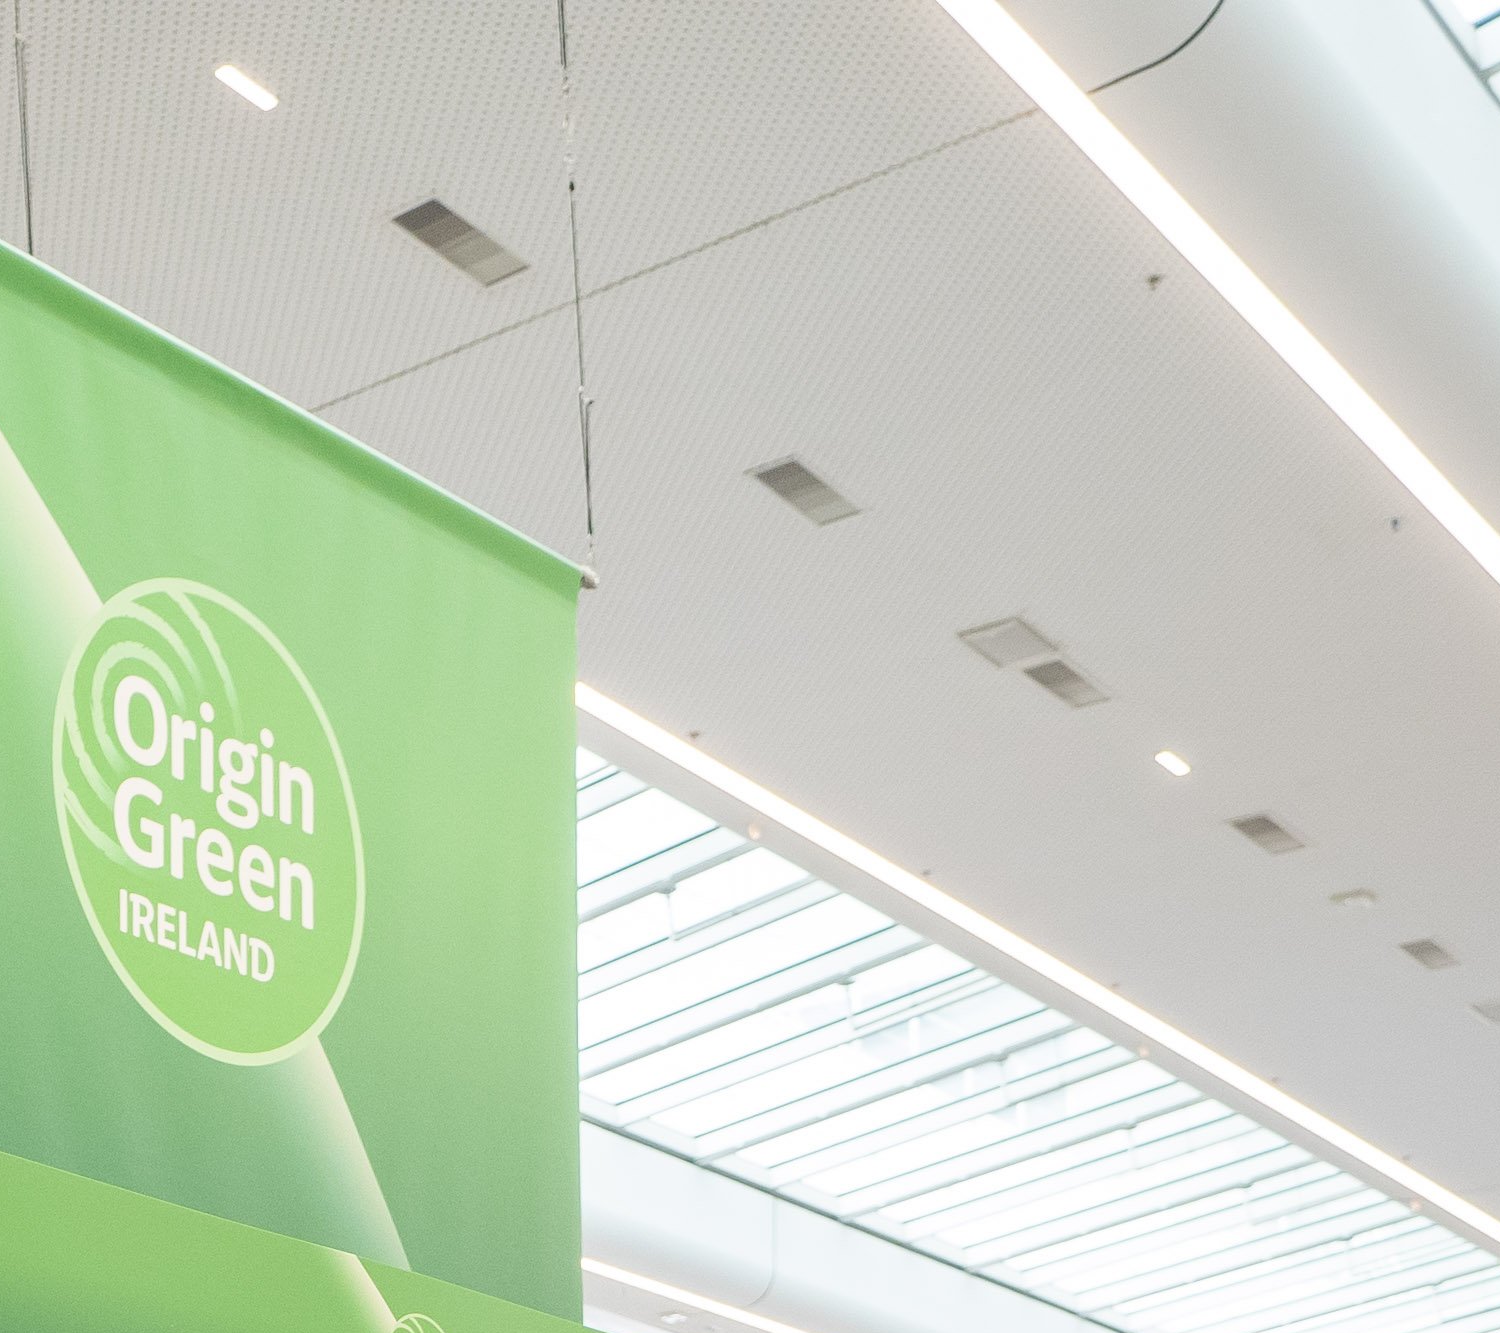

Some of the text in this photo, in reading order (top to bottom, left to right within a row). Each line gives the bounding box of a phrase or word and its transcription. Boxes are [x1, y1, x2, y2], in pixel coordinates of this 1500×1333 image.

[113, 675, 314, 834] Origin
[113, 776, 314, 930] Green
[119, 888, 275, 982] IRELAND
